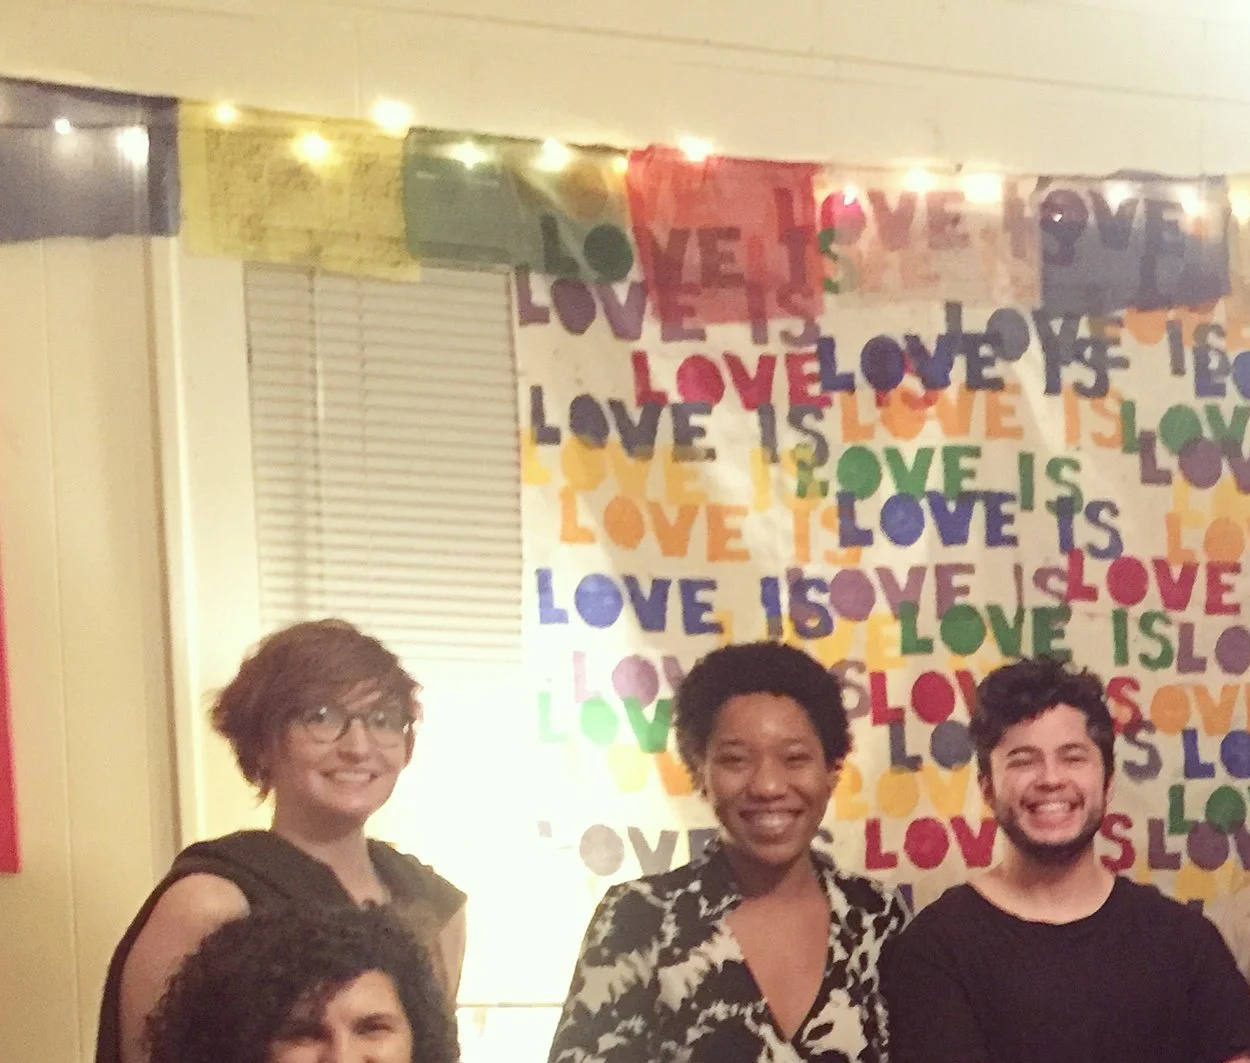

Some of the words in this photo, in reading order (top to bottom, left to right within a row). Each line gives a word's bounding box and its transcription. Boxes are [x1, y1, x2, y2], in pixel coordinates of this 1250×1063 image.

[515, 263, 707, 343] LOVE
[746, 279, 821, 347] IS
[632, 350, 833, 411] LOVE
[815, 333, 1006, 392] LOVE
[530, 384, 716, 463] LOVE
[757, 402, 829, 464] IS
[839, 380, 1025, 442] LOVE
[1062, 384, 1125, 449] IS
[1018, 452, 1084, 517] IS
[559, 487, 750, 562] LOVE
[837, 489, 1020, 548] LOVE
[1056, 495, 1124, 561] IS
[535, 568, 724, 636] LOVE
[760, 576, 834, 640] IS
[1067, 549, 1242, 616] LOVE
[900, 601, 1073, 663] LOVE
[1112, 608, 1175, 672] IS
[537, 691, 676, 754] LOV
[1106, 676, 1143, 736] S
[1123, 720, 1163, 783] S
[865, 816, 998, 871] LOV
[1100, 812, 1136, 874] S
